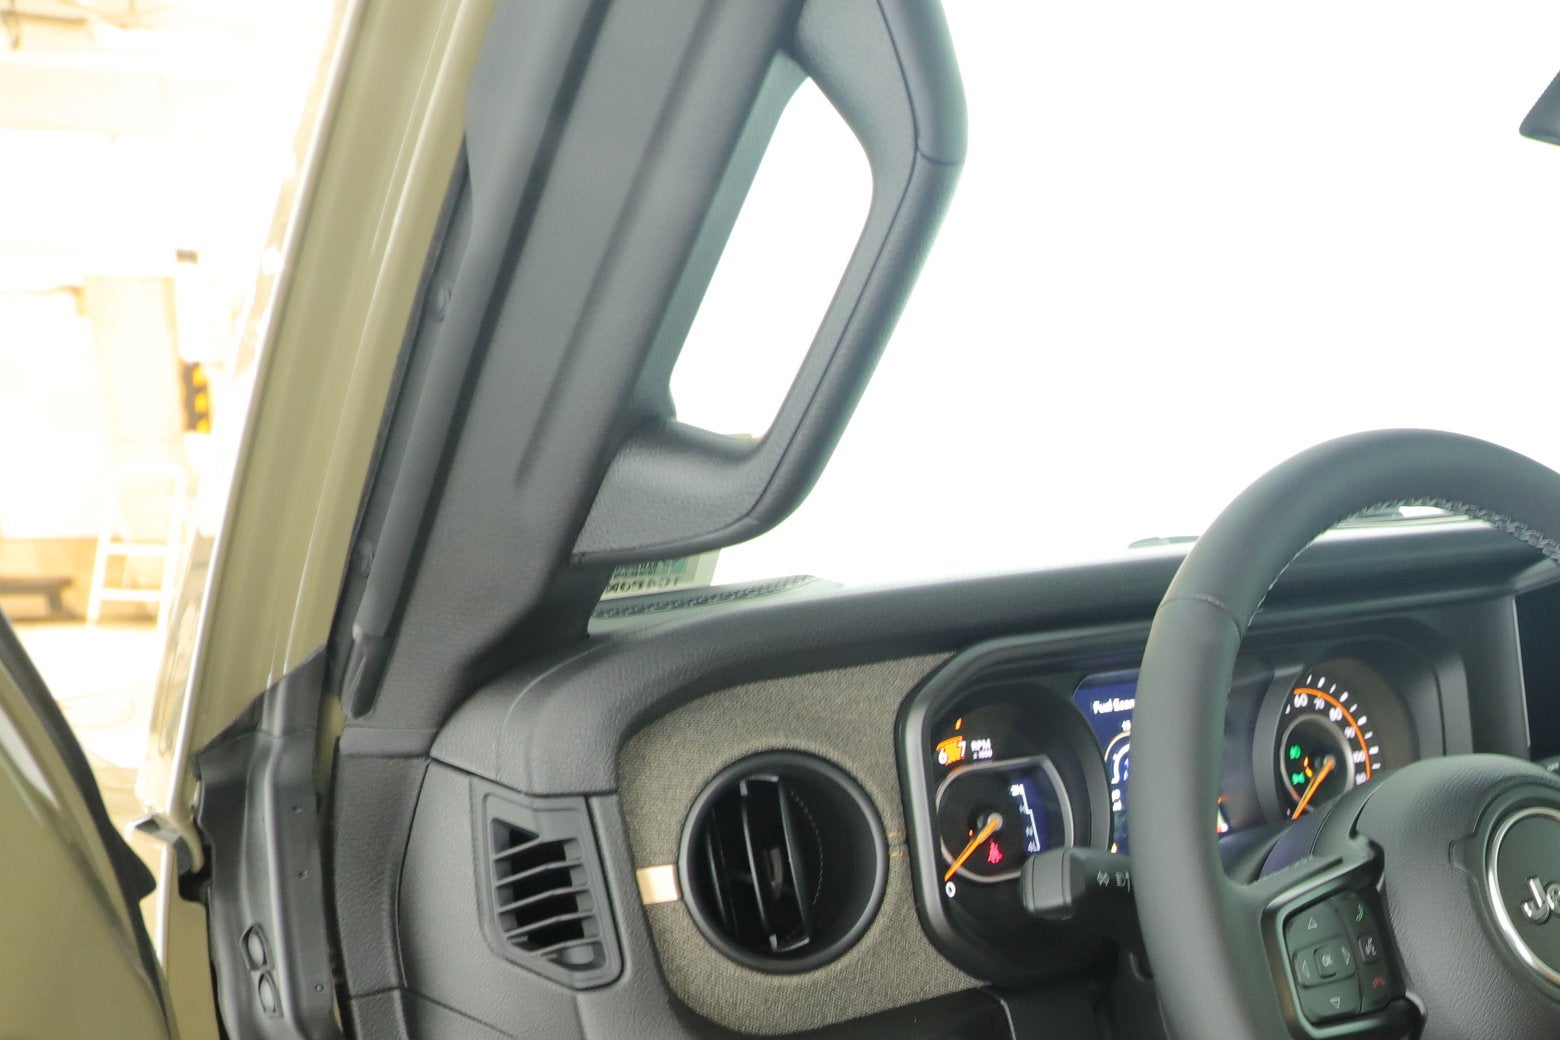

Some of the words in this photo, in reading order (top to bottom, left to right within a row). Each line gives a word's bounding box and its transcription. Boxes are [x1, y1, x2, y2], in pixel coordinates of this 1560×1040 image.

[1293, 693, 1309, 708] 60
[938, 747, 948, 765] 6
[957, 740, 967, 757] 7
[971, 738, 991, 752] RPM
[945, 881, 956, 898] 0
